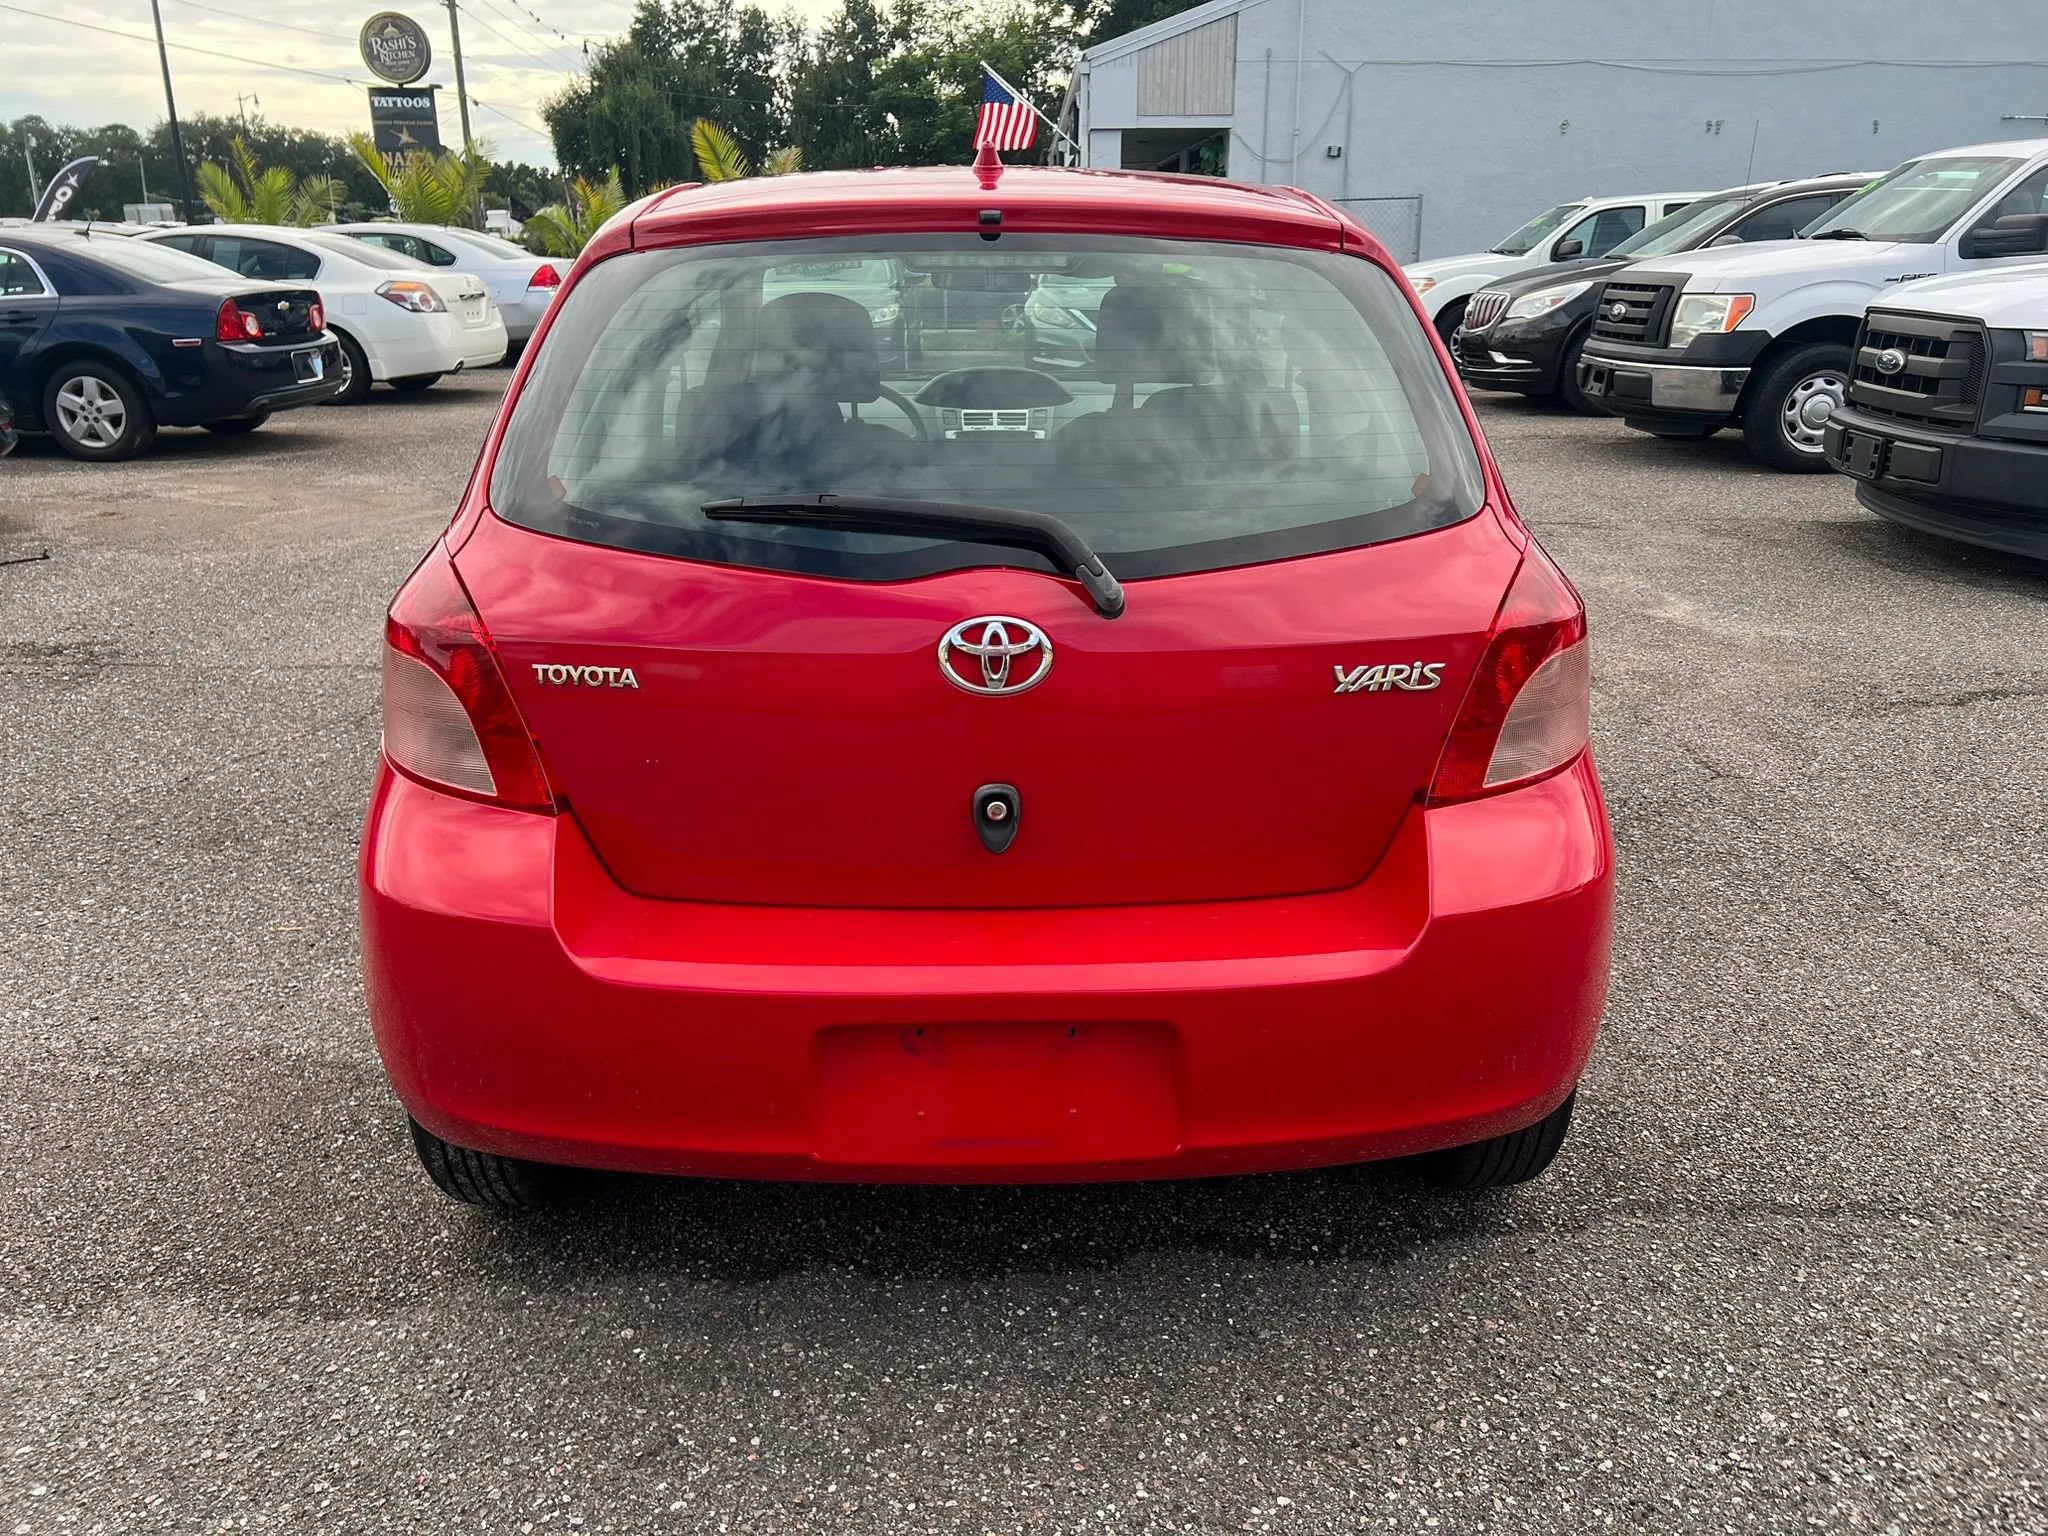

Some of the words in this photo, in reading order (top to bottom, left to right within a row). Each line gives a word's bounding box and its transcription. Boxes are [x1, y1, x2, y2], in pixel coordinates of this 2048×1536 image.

[368, 35, 417, 55] RASHI'S
[379, 50, 416, 64] KITCHEN
[371, 96, 431, 108] TATTOOS
[532, 663, 639, 688] TOYOTA
